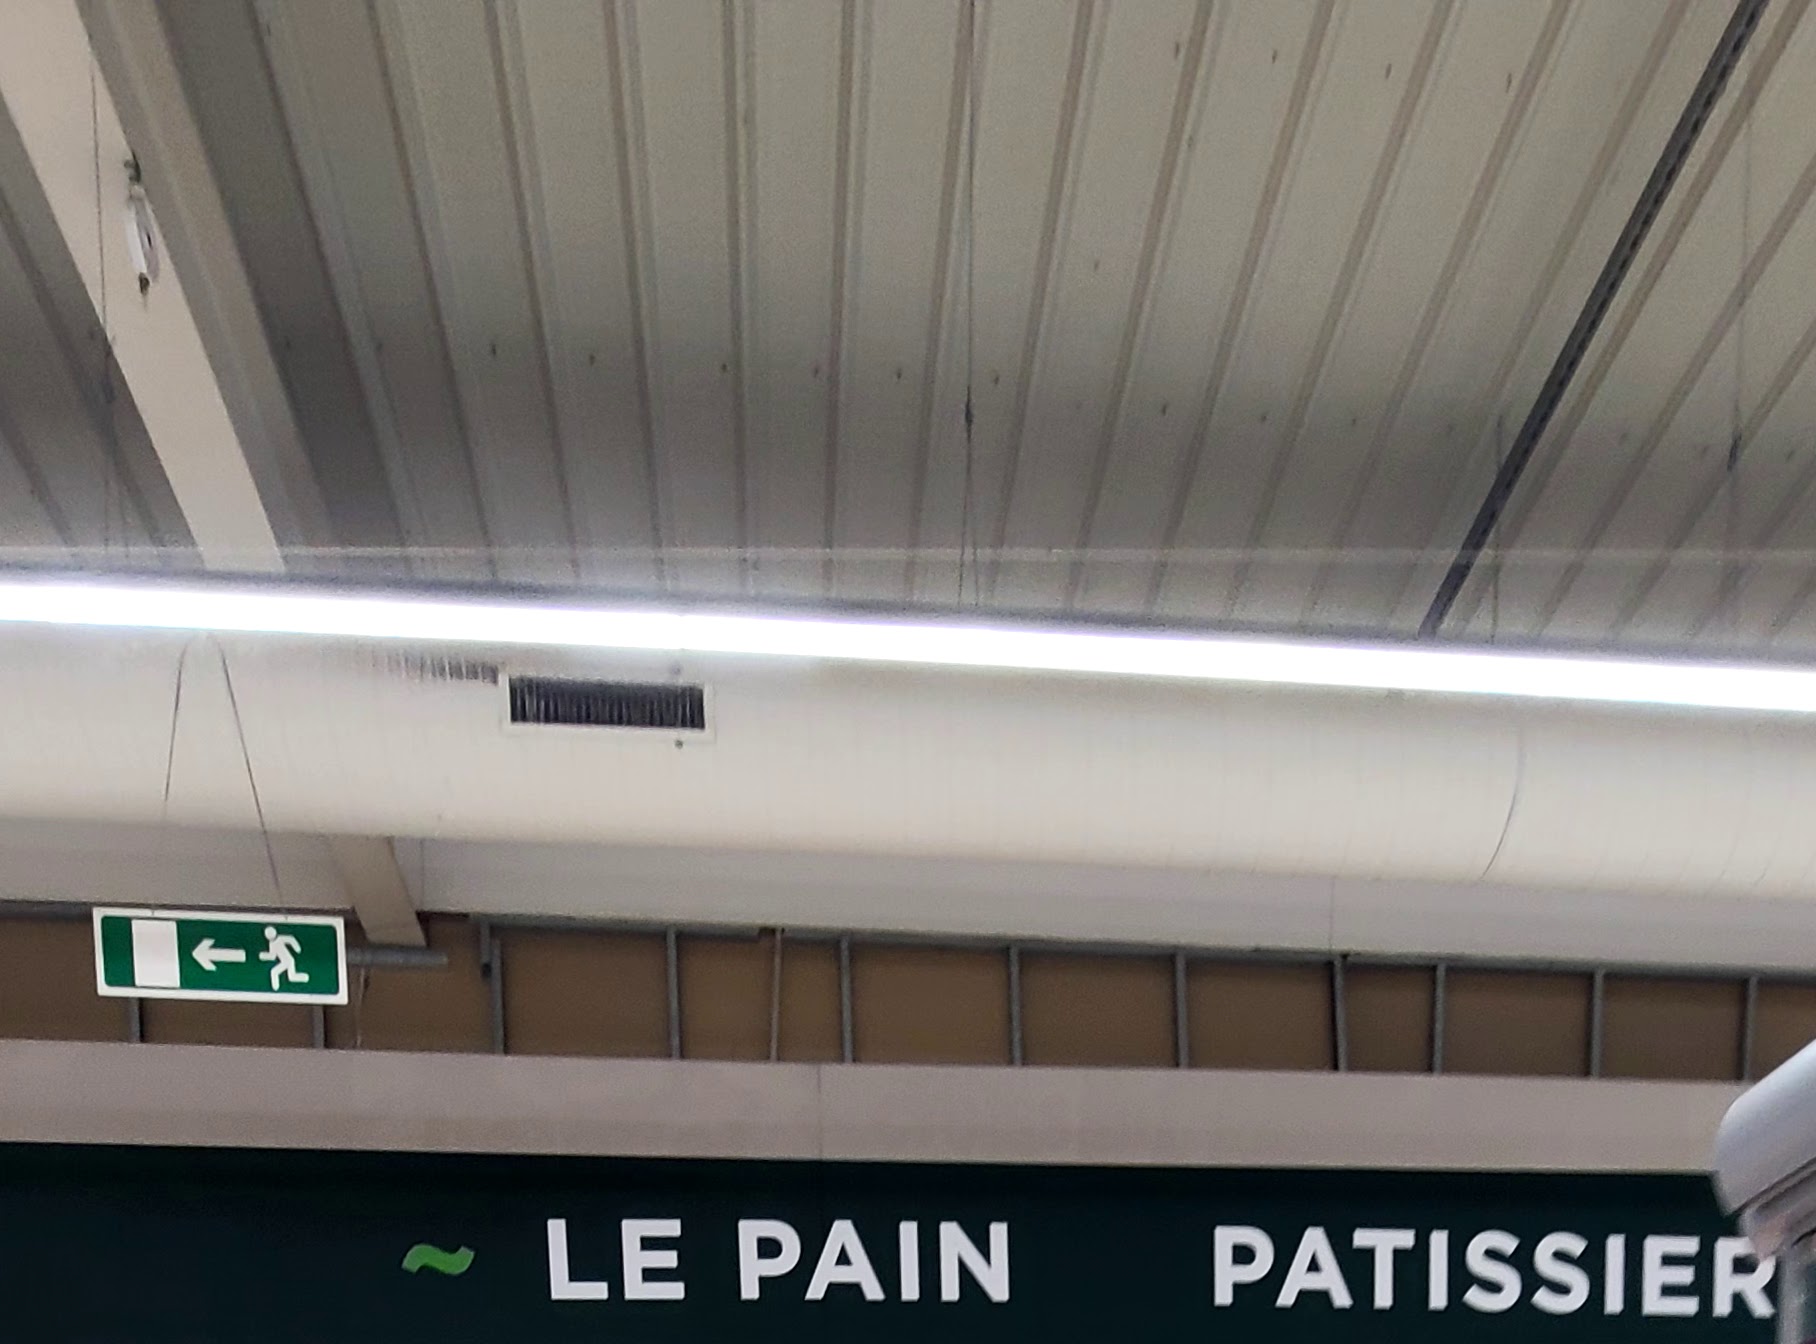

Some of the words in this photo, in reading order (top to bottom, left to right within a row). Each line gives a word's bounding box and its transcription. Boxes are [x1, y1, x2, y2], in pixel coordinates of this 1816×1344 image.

[546, 1217, 686, 1301] LE
[737, 1218, 1011, 1304] PAIN
[1212, 1224, 1777, 1319] PATISSIER
